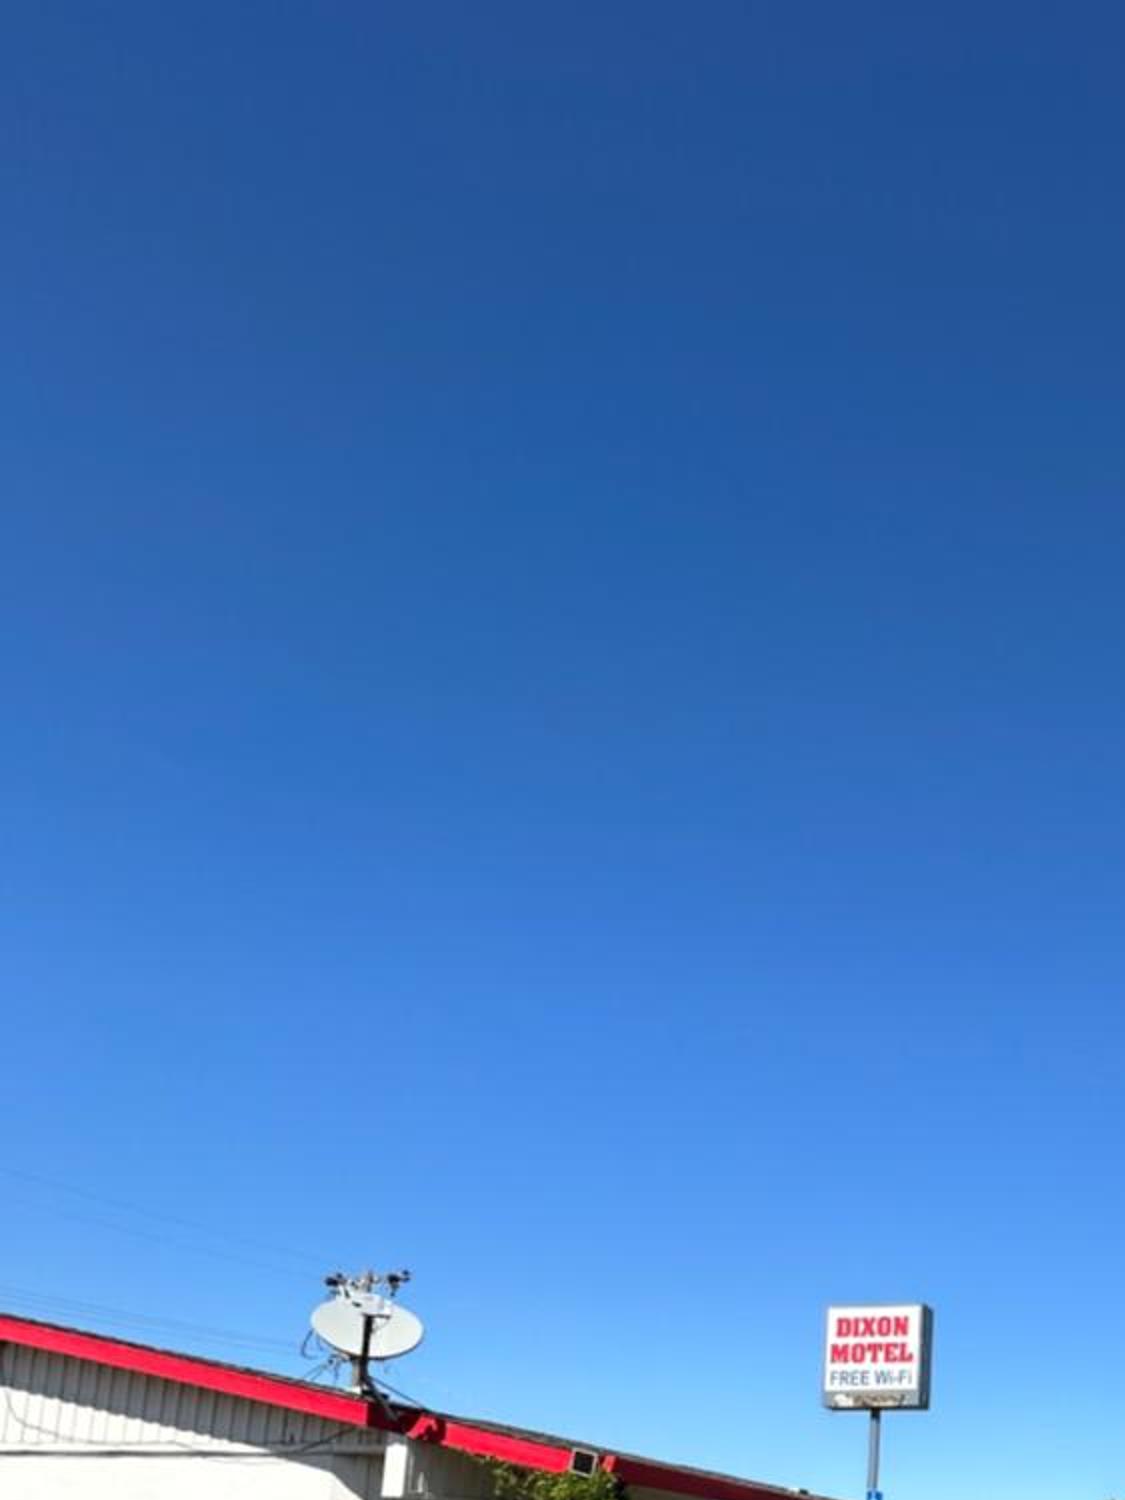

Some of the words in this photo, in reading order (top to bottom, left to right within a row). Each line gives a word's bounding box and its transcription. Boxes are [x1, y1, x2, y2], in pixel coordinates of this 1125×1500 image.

[836, 1316, 908, 1338] DIXON
[830, 1342, 913, 1363] MOTEL
[830, 1369, 869, 1386] FREE
